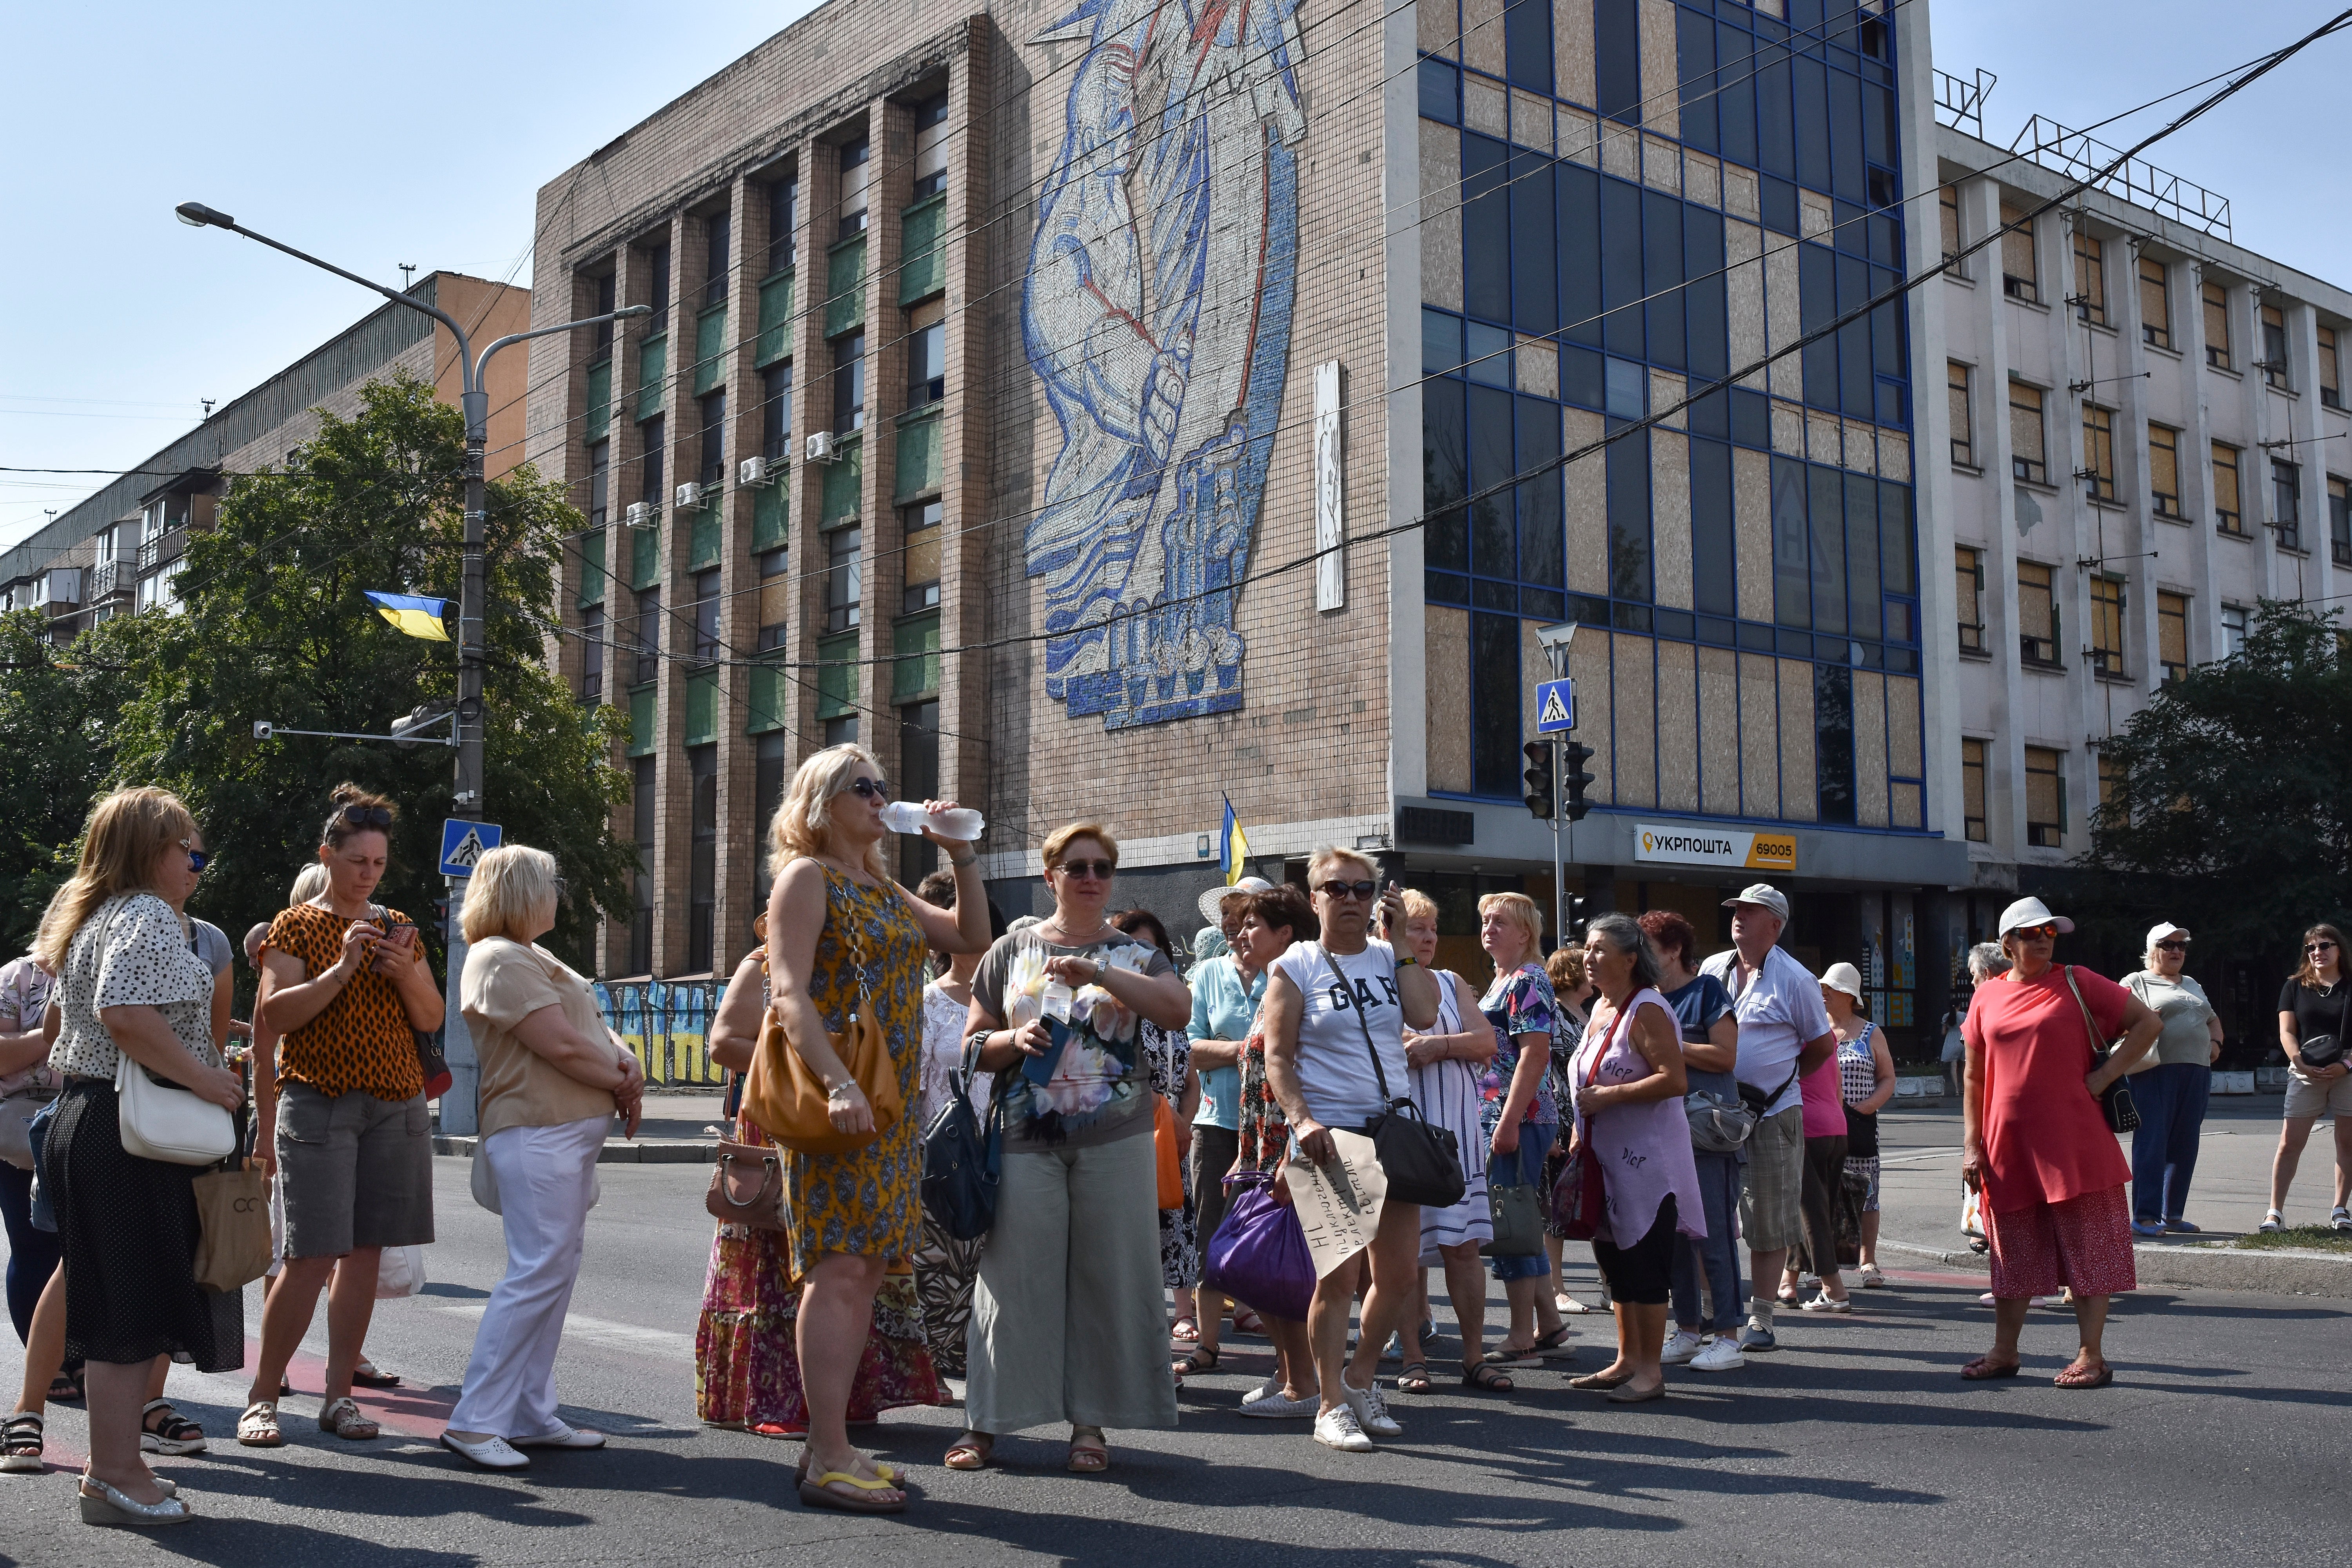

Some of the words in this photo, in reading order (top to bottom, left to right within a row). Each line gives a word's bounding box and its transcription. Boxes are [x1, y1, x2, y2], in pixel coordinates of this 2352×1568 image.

[1654, 835, 1732, 855] УКРПОШТА
[1756, 843, 1792, 856] 69005
[1328, 975, 1398, 1011] GAP
[1323, 1161, 1364, 1246] електрик
